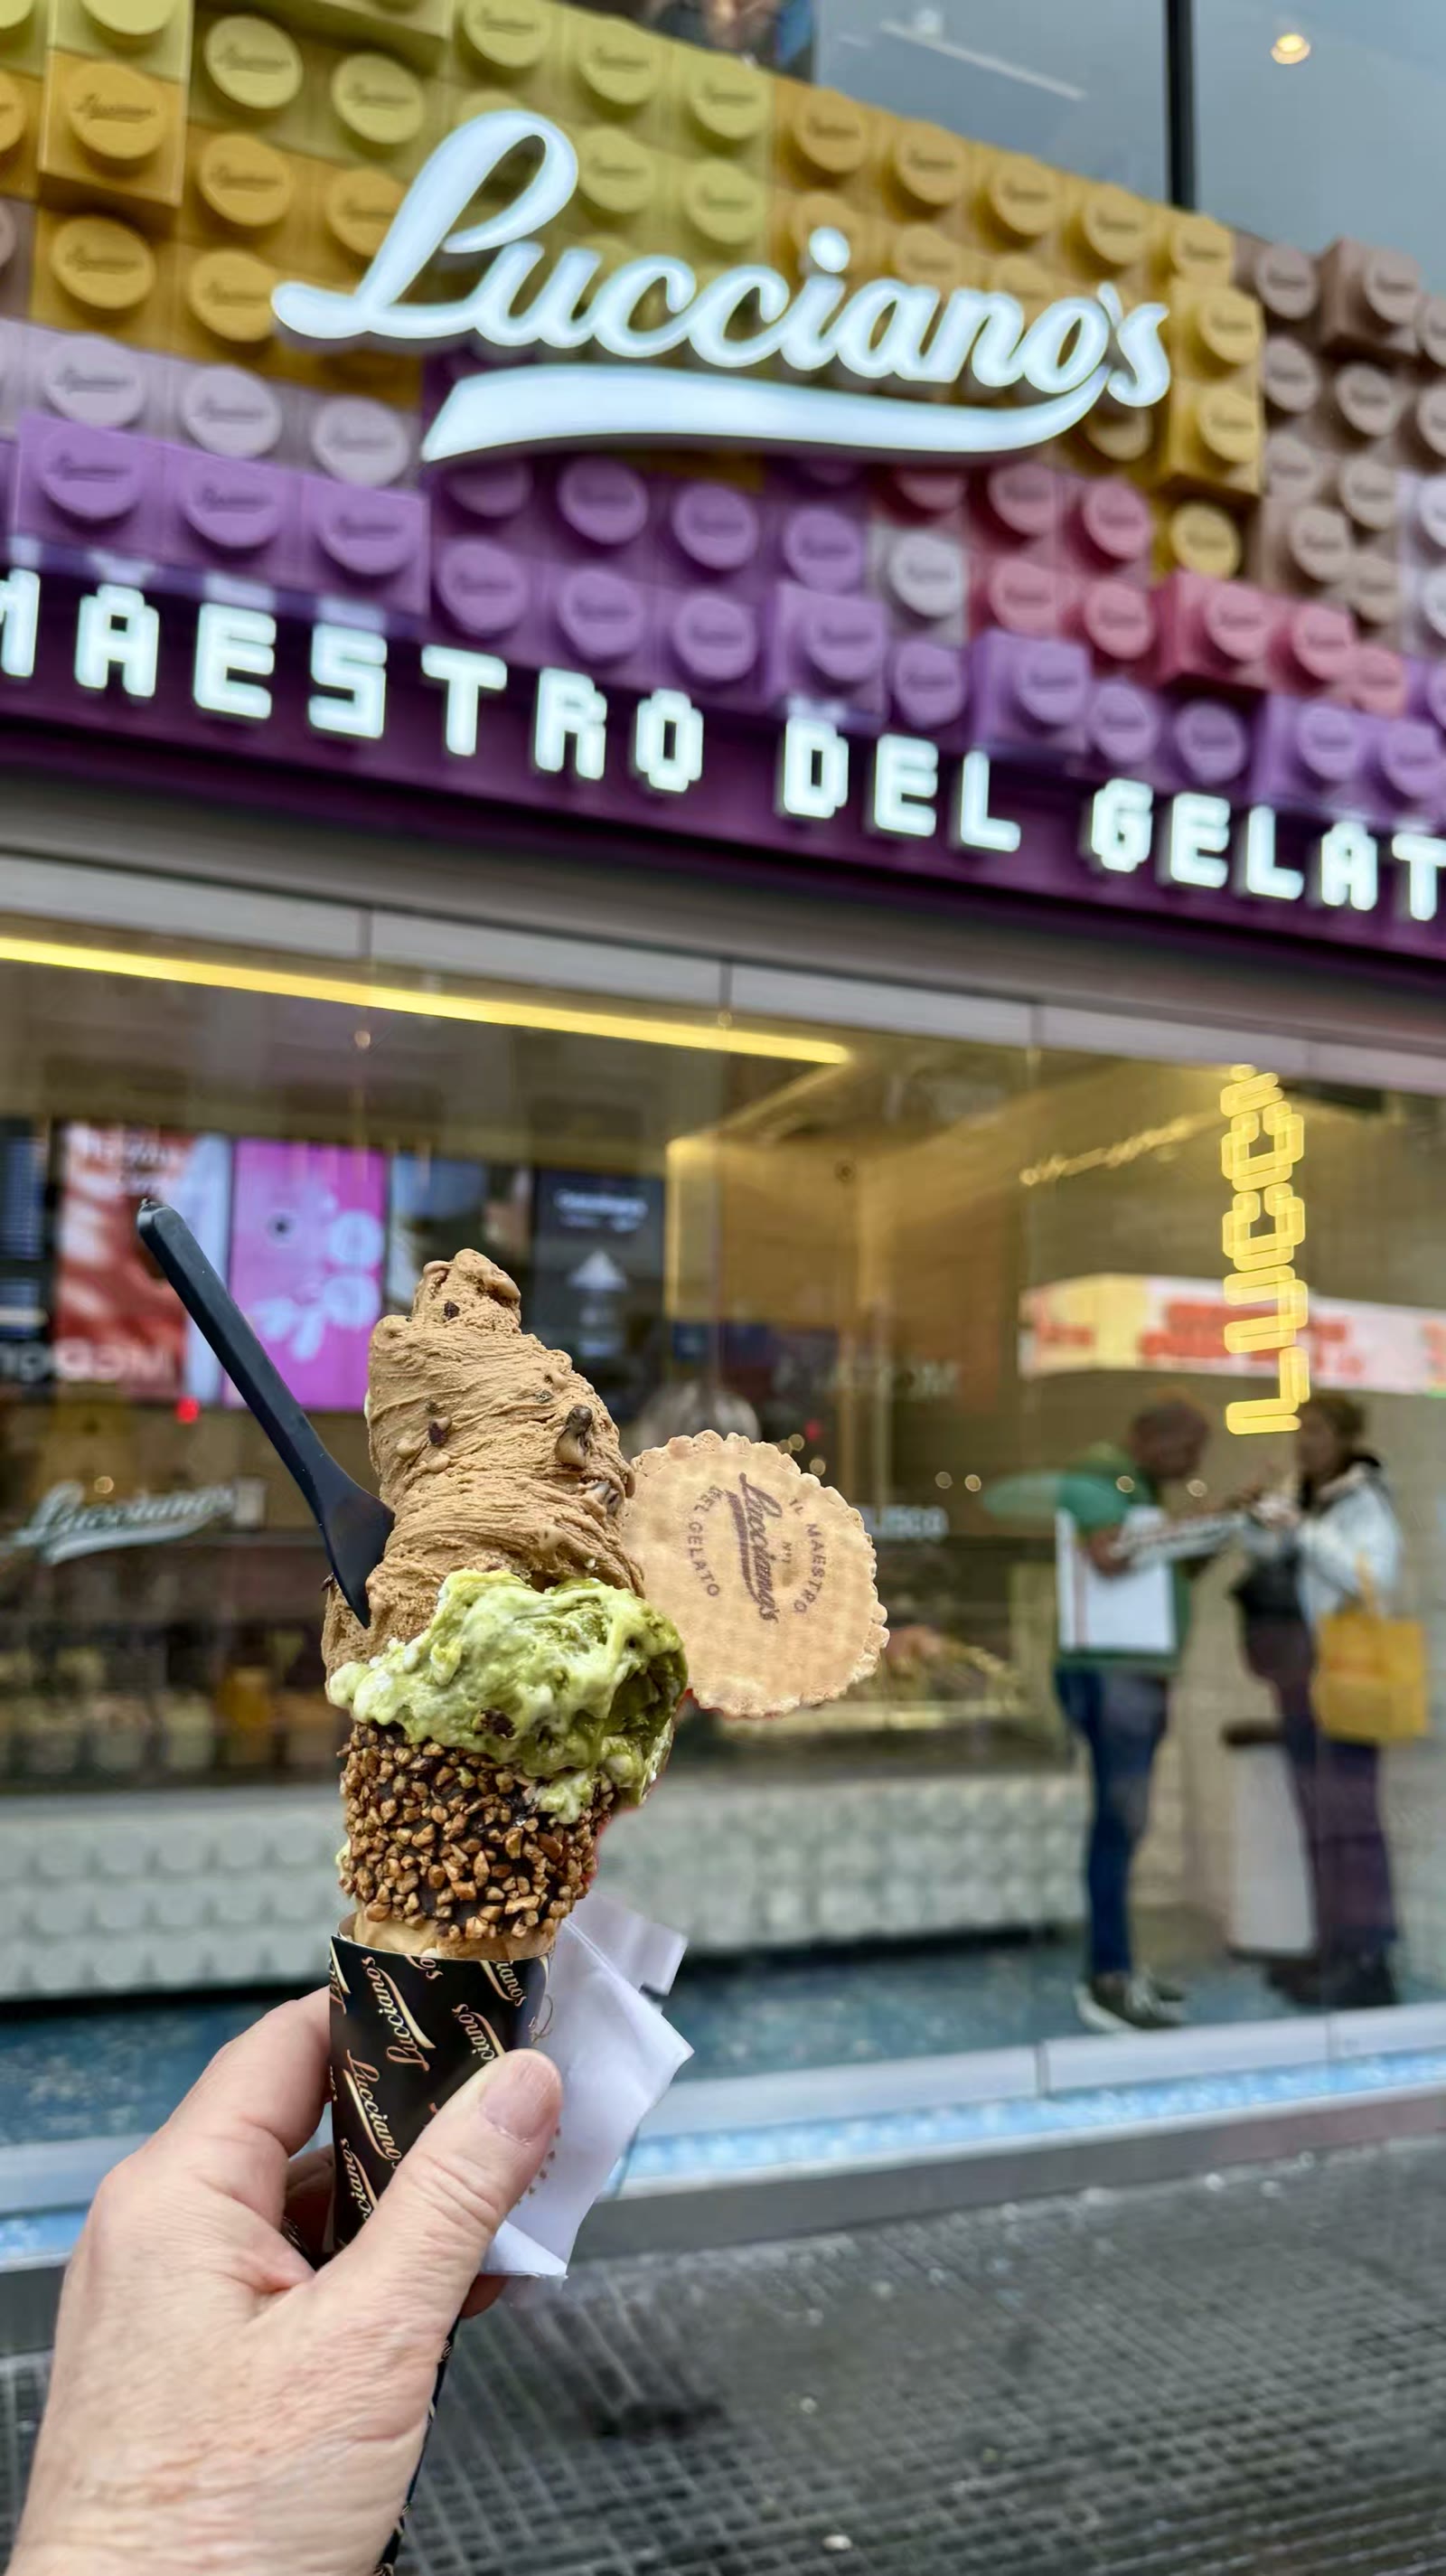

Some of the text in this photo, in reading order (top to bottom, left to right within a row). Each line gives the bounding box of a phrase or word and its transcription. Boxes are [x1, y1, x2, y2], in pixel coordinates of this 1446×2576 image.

[272, 108, 1171, 408] Lucciano's
[782, 715, 1021, 852] DEL
[1091, 777, 1446, 922] GELAT
[688, 1521, 720, 1597] GELATO
[793, 1523, 826, 1613] MAESTRO
